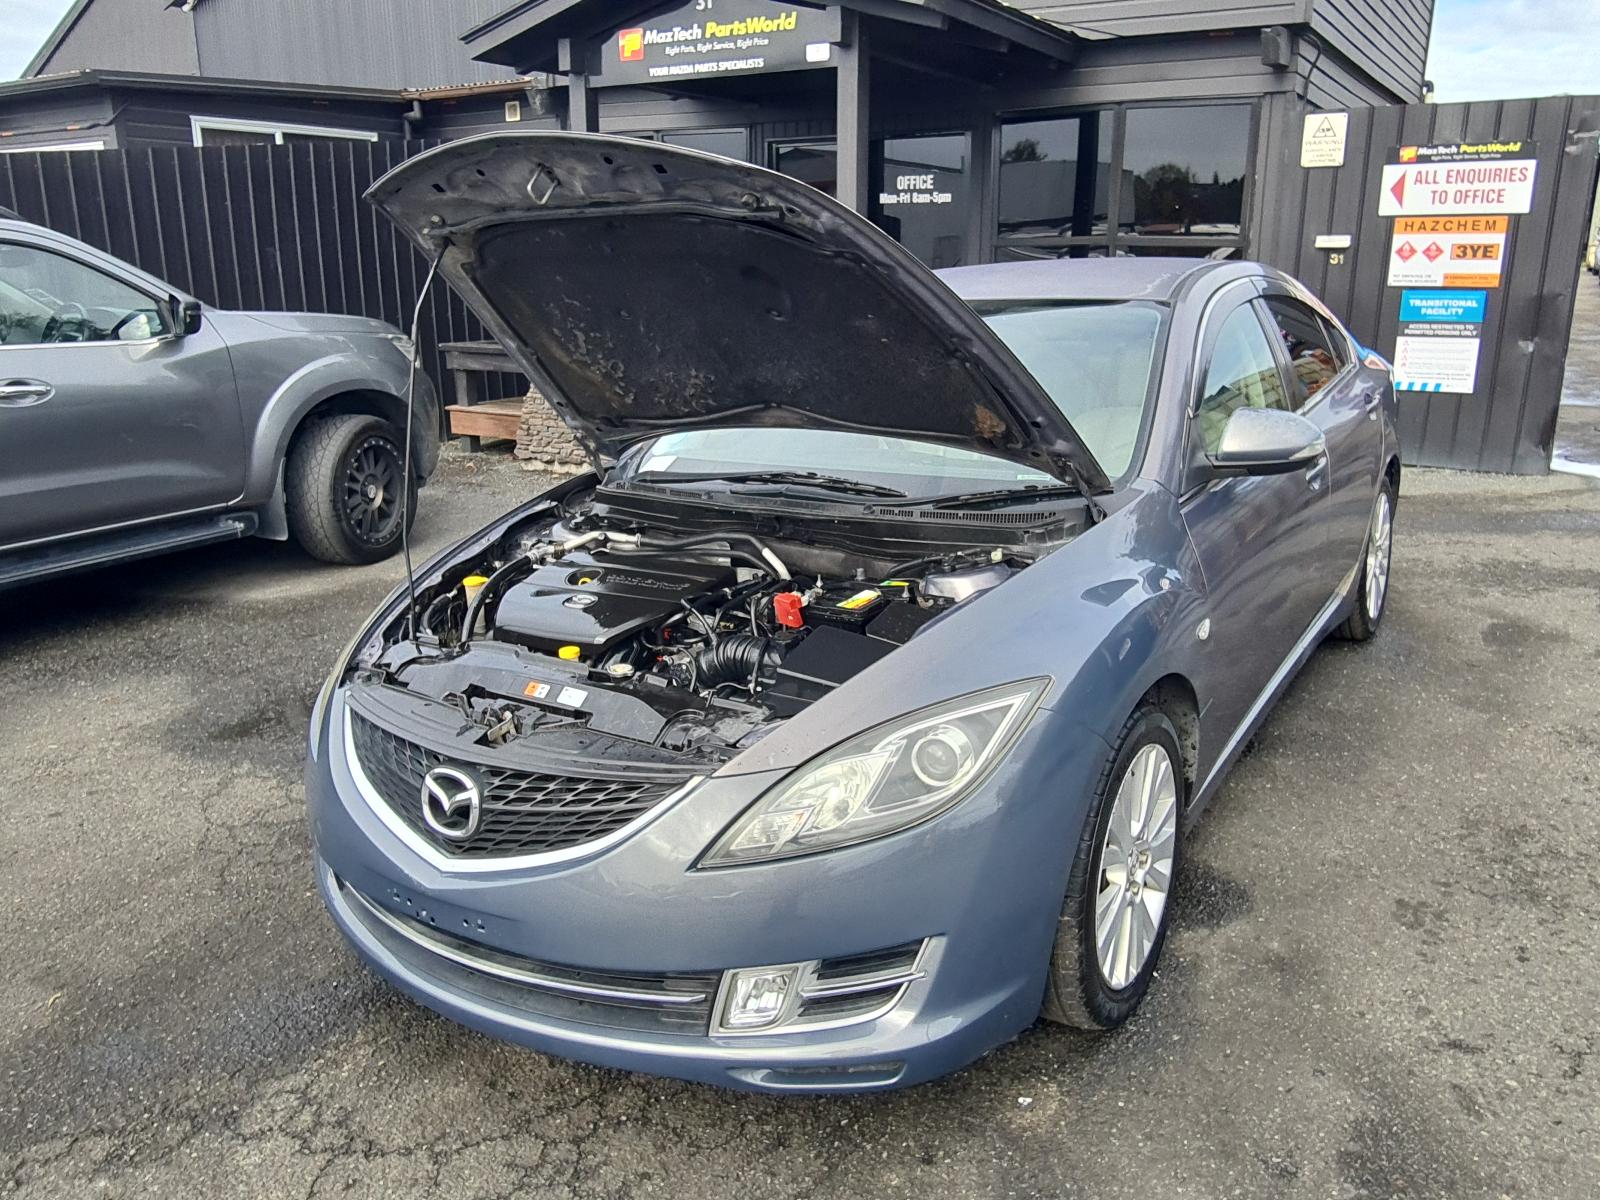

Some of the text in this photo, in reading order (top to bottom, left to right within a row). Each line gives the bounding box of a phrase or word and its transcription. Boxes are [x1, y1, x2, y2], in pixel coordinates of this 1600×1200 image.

[643, 11, 797, 45] MazTech PartsWorld
[649, 66, 669, 77] YOUR
[694, 62, 718, 73] PARTS
[718, 58, 765, 71] SPECIALISTS
[1459, 142, 1522, 153] PartsWorld
[896, 175, 934, 190] OFFICE
[1414, 167, 1529, 185] ALL ENQUIRIES
[879, 191, 952, 204] Mon-Fri 8am-5pm
[1430, 188, 1506, 205] TO OFFICE
[1403, 219, 1497, 232] HAZCHEM
[1455, 245, 1494, 259] 3YE
[1329, 253, 1344, 265] 31
[1409, 299, 1478, 307] TRANSITIONAL
[1420, 307, 1464, 316] FACILITY
